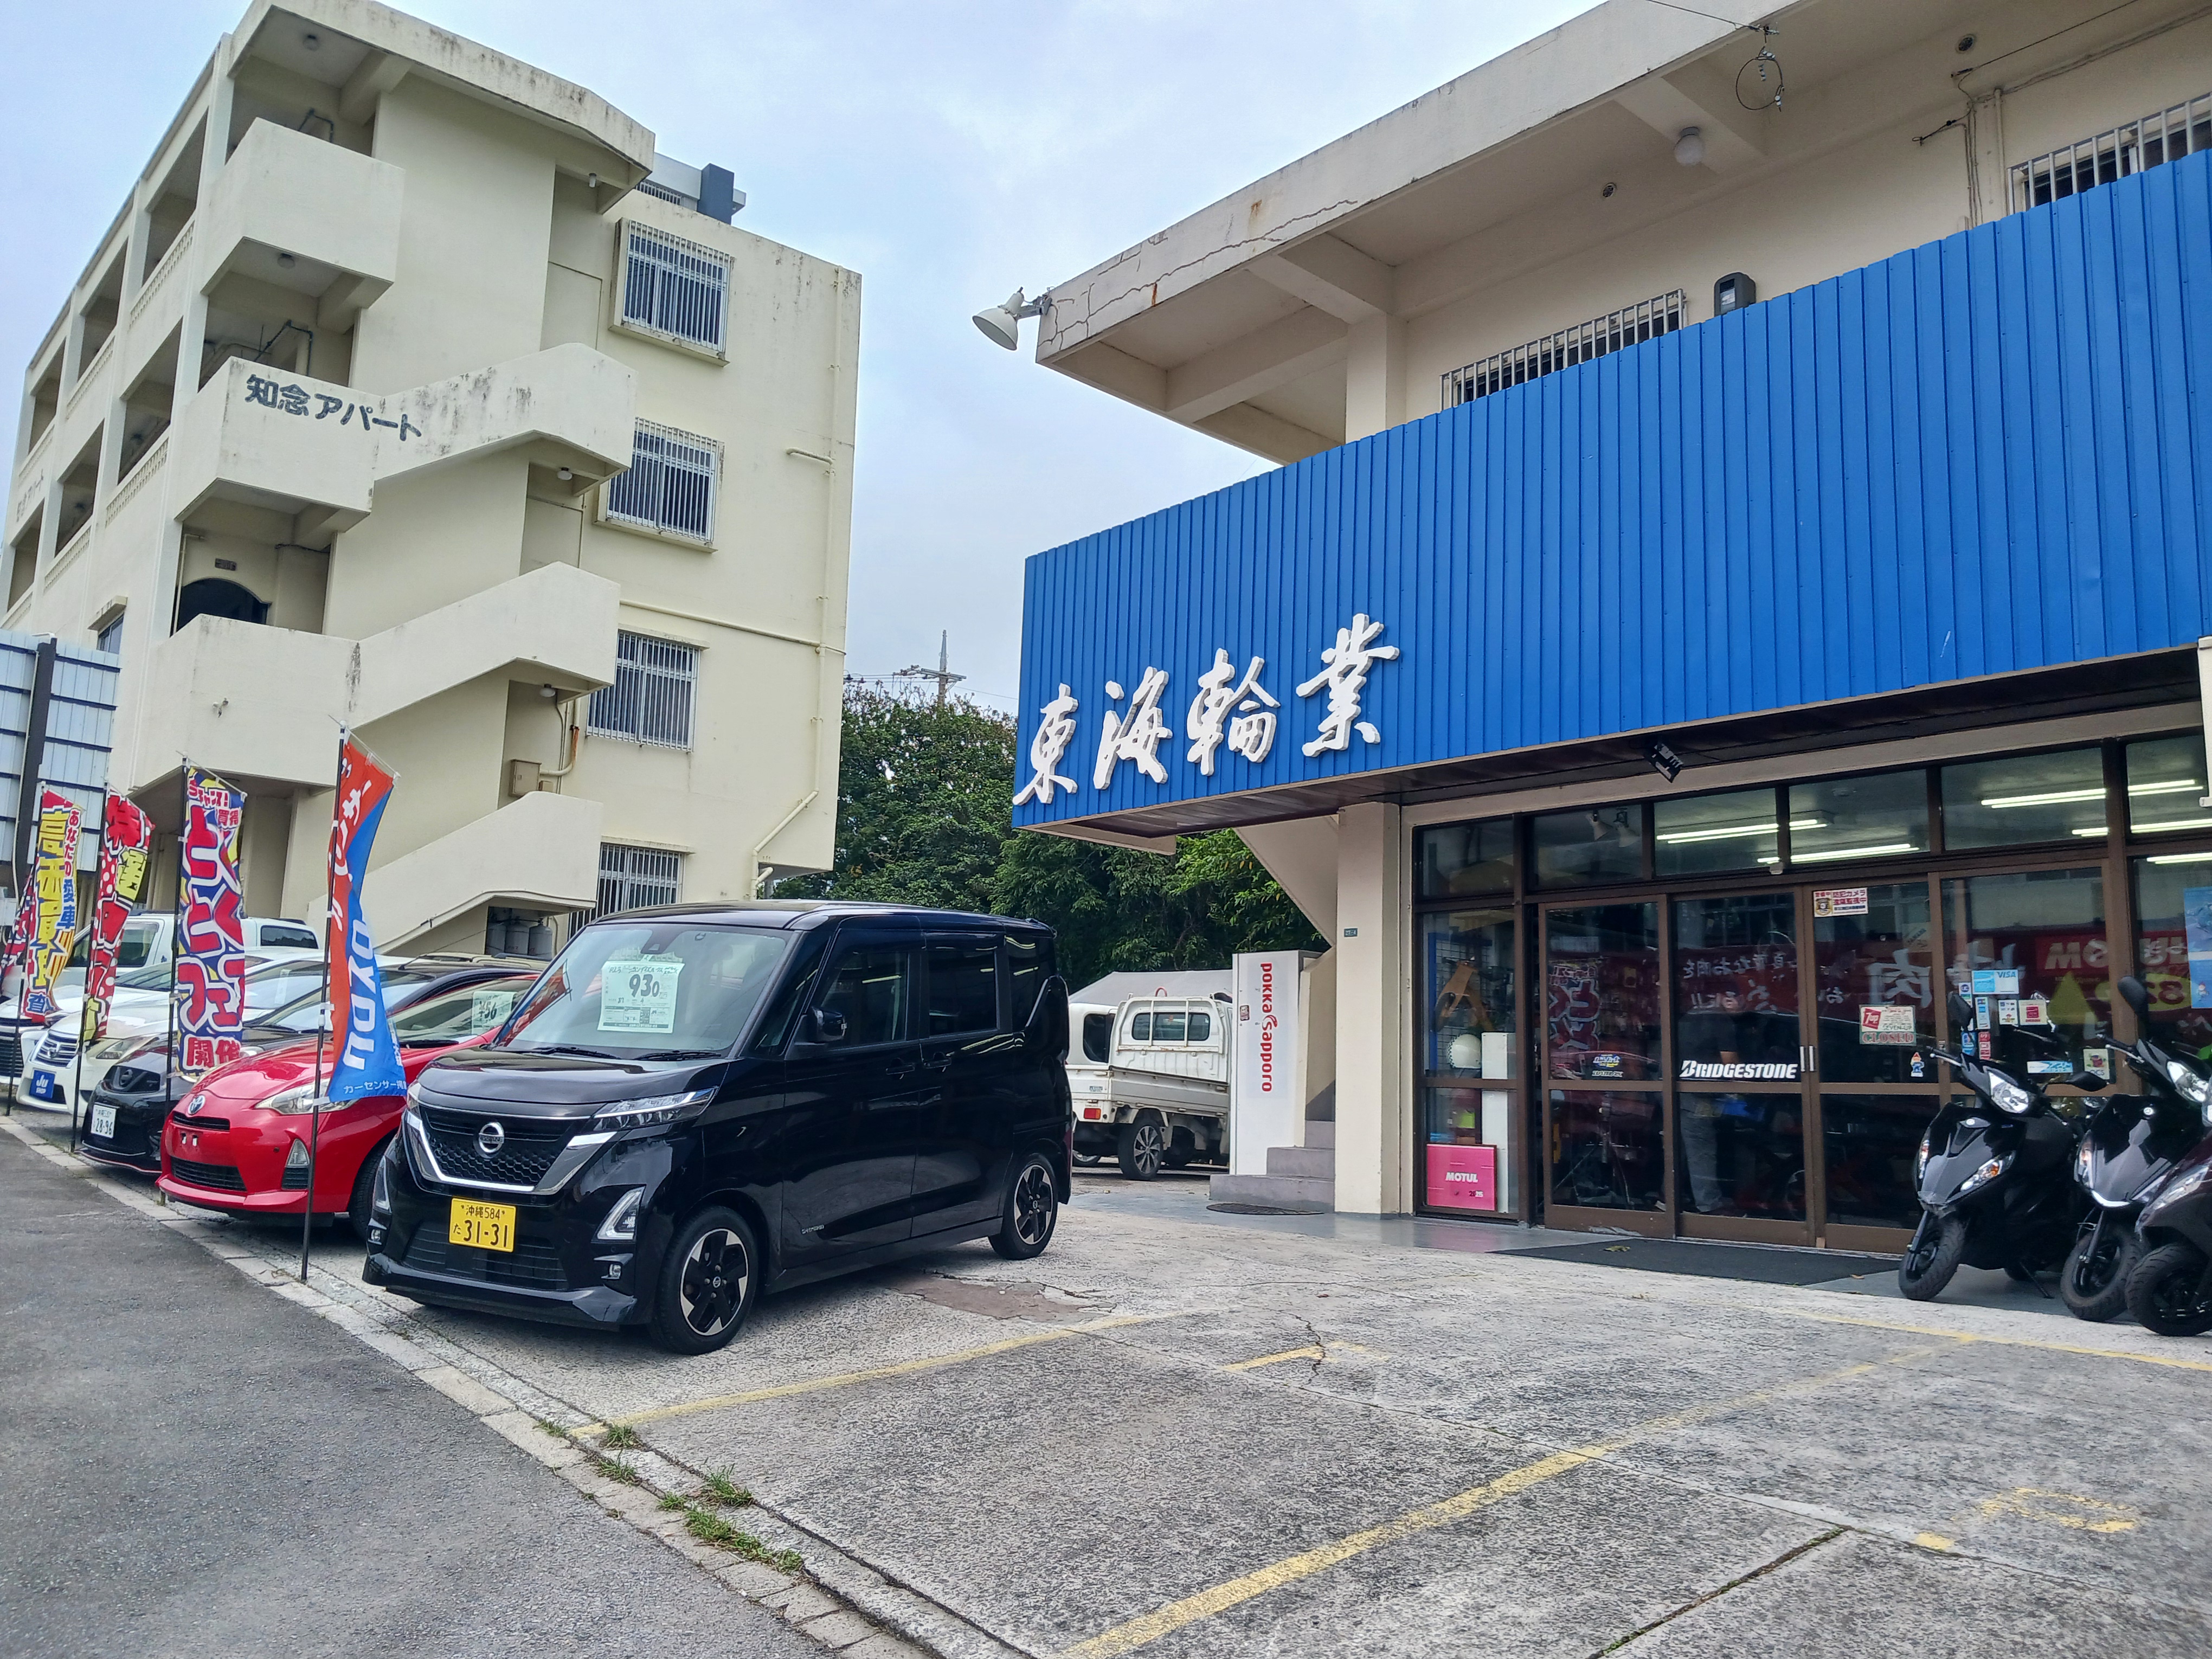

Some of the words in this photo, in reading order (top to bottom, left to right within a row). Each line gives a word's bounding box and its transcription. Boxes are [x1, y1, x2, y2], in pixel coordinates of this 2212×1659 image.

[245, 374, 422, 442] 知念アパート
[1012, 613, 1400, 806] 東海輪業
[1862, 1032, 1914, 1044] CLOSED
[1679, 1060, 1798, 1079] BRIDGESTONE
[1445, 1172, 1478, 1183] MOTUL
[463, 1219, 508, 1248] 31-31
